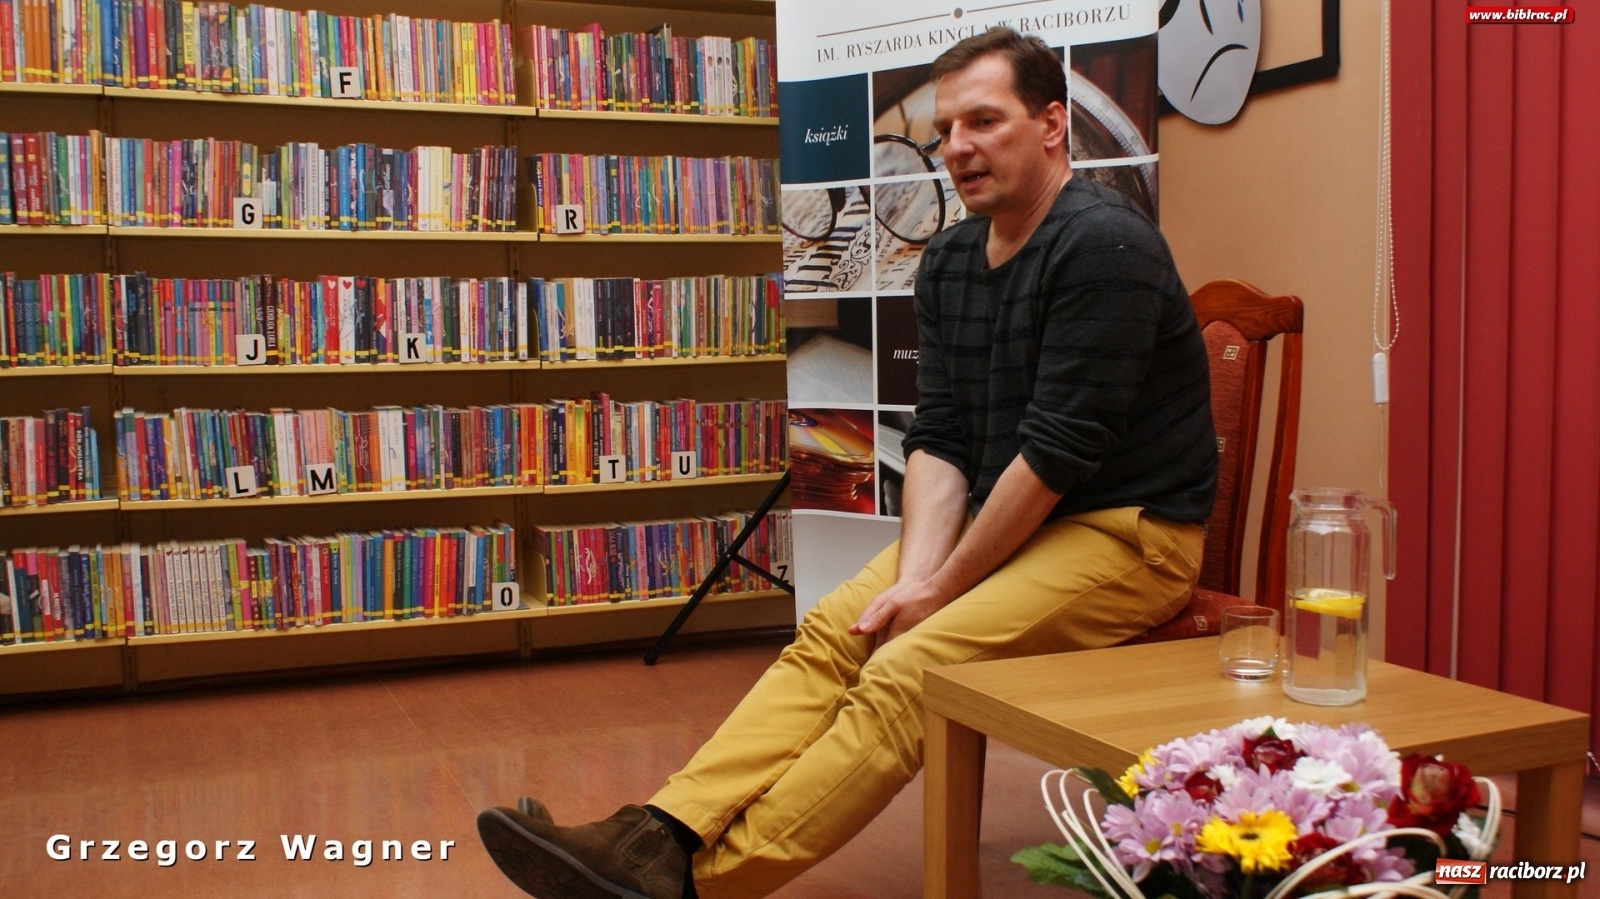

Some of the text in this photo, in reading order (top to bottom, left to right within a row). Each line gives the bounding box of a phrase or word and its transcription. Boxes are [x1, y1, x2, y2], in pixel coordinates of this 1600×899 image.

[817, 47, 840, 62] IM.
[846, 34, 922, 59] RYSZARDA
[1020, 4, 1131, 32] RACIBORZU
[339, 72, 352, 94] F
[804, 125, 848, 146] książki
[241, 204, 255, 225] G
[565, 209, 578, 230] R
[246, 339, 258, 360] J
[407, 337, 420, 359] K
[893, 349, 919, 364] muz
[608, 459, 619, 479] T
[679, 456, 690, 475] U
[234, 472, 249, 494] L
[310, 468, 334, 491] M
[777, 565, 788, 583] Z
